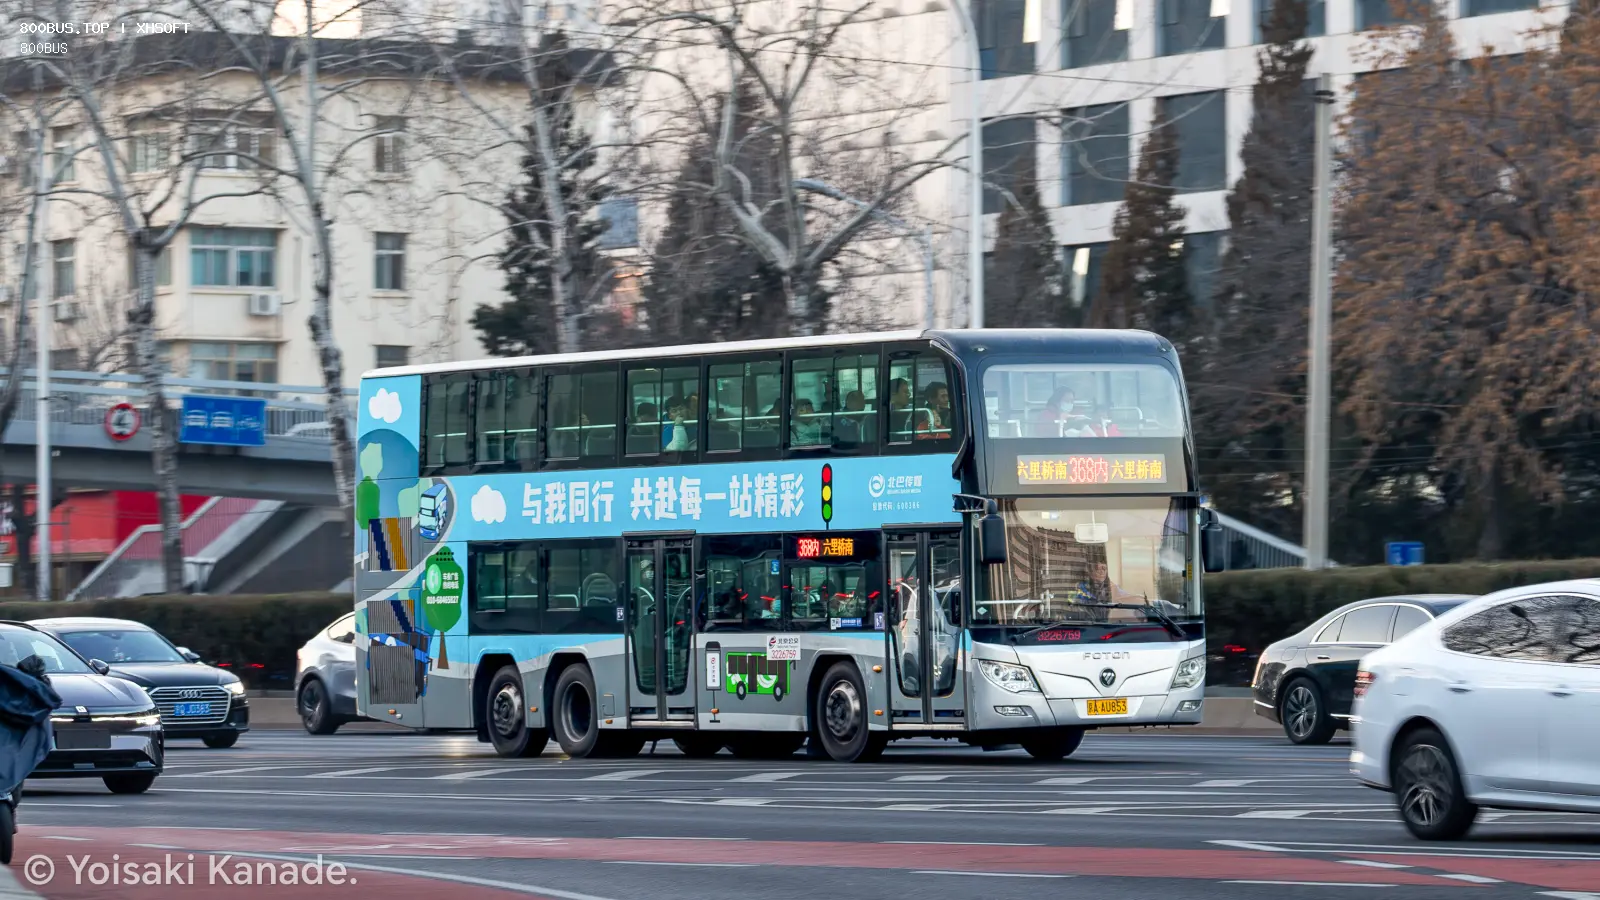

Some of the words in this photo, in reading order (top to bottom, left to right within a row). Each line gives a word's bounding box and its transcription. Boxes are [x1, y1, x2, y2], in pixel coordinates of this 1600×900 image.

[1017, 460, 1067, 481] 六里桥南
[1069, 457, 1109, 483] 368内
[1111, 460, 1163, 480] 六里桥南
[521, 480, 614, 525] 与我同行
[631, 472, 804, 520] 共赴每一站精彩
[799, 538, 820, 557] 368内
[823, 538, 854, 556] 六里桥南
[1037, 630, 1081, 641] 3226759
[771, 650, 797, 659] 3226759
[1082, 651, 1131, 660] FOTON
